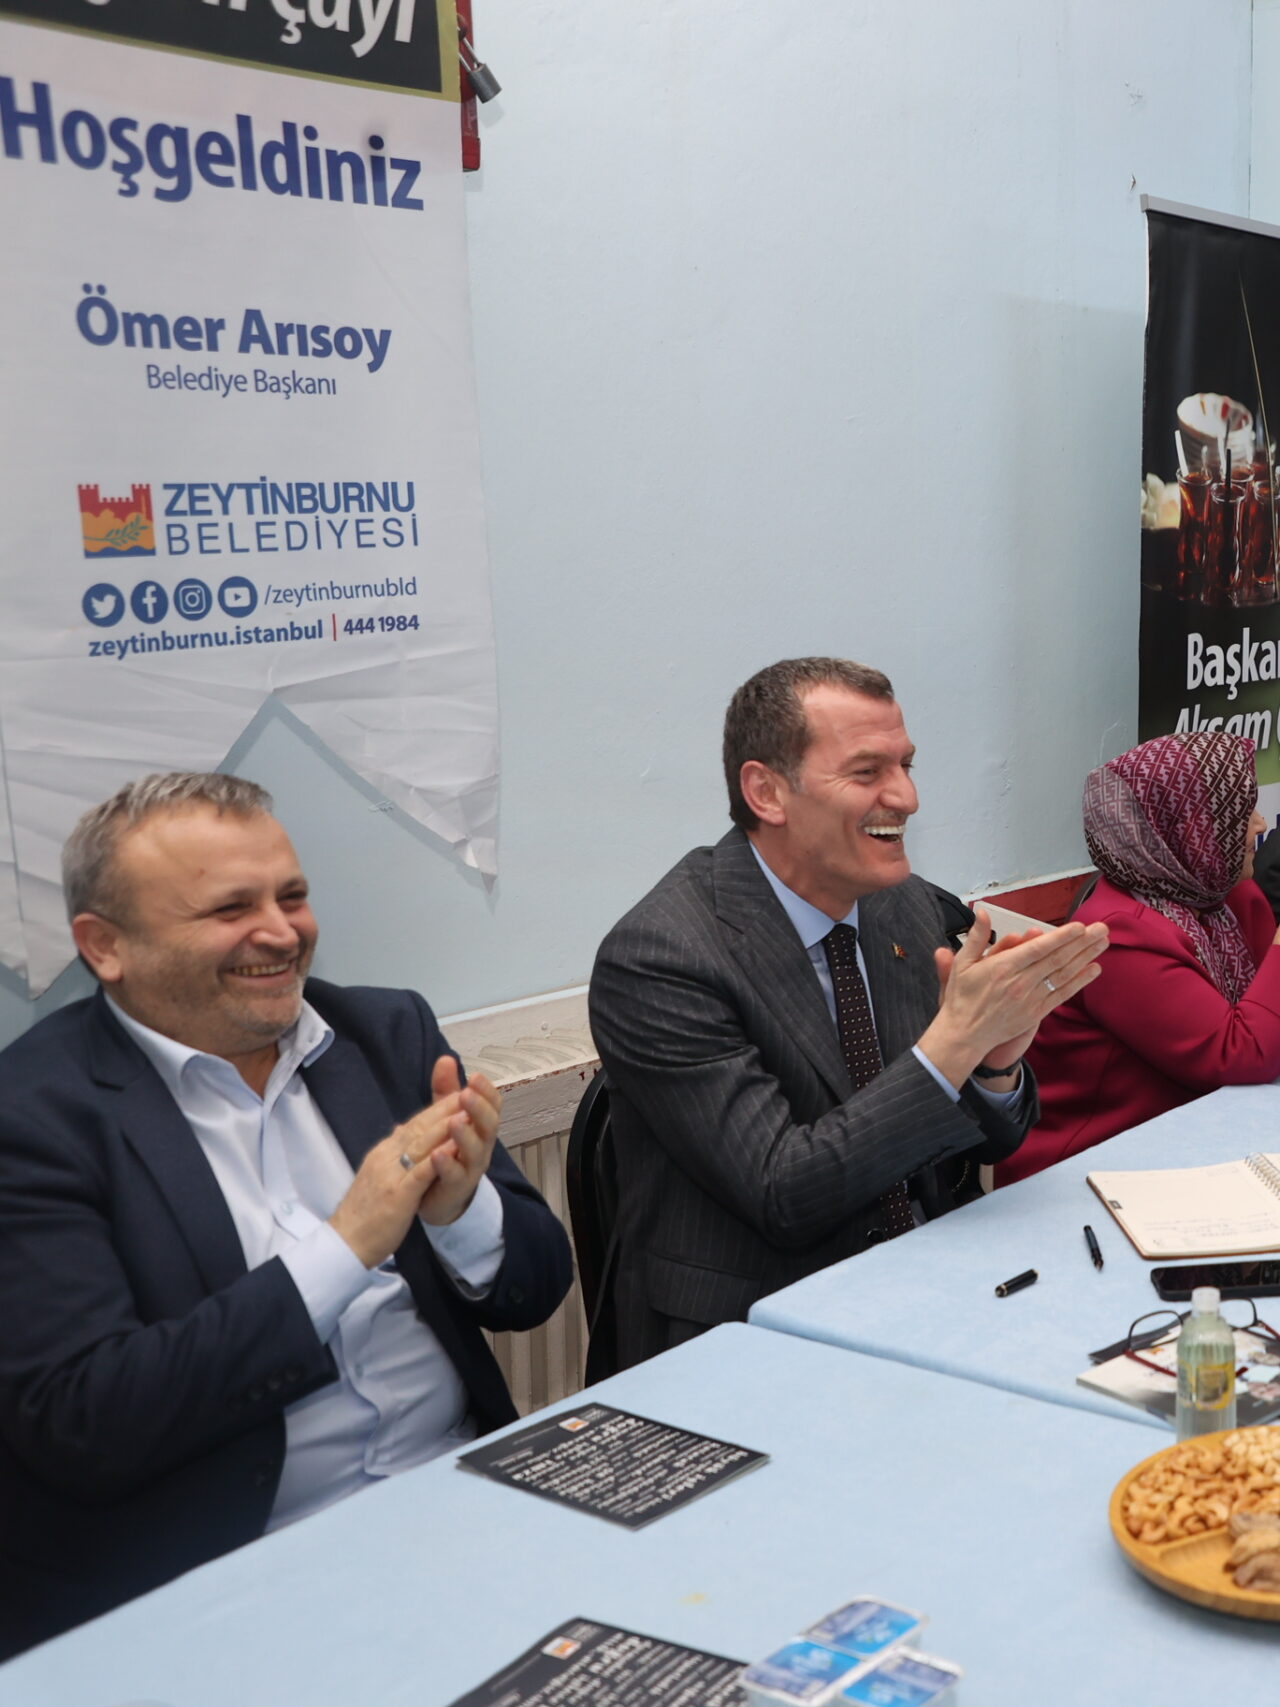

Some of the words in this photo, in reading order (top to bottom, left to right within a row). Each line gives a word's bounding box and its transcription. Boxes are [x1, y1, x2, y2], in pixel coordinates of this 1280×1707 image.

[0, 76, 425, 211] Hoşgeldiniz
[76, 283, 226, 352] Ömer
[237, 308, 393, 374] Arısoy
[146, 364, 249, 398] Belediye
[253, 369, 338, 400] Başkanı
[162, 476, 416, 517] ZEYTİNBURNU
[166, 513, 420, 556] BELEDİYESİ
[264, 577, 418, 607] /zeytinburnubld
[88, 619, 324, 661] zeytinburnu.istanbul
